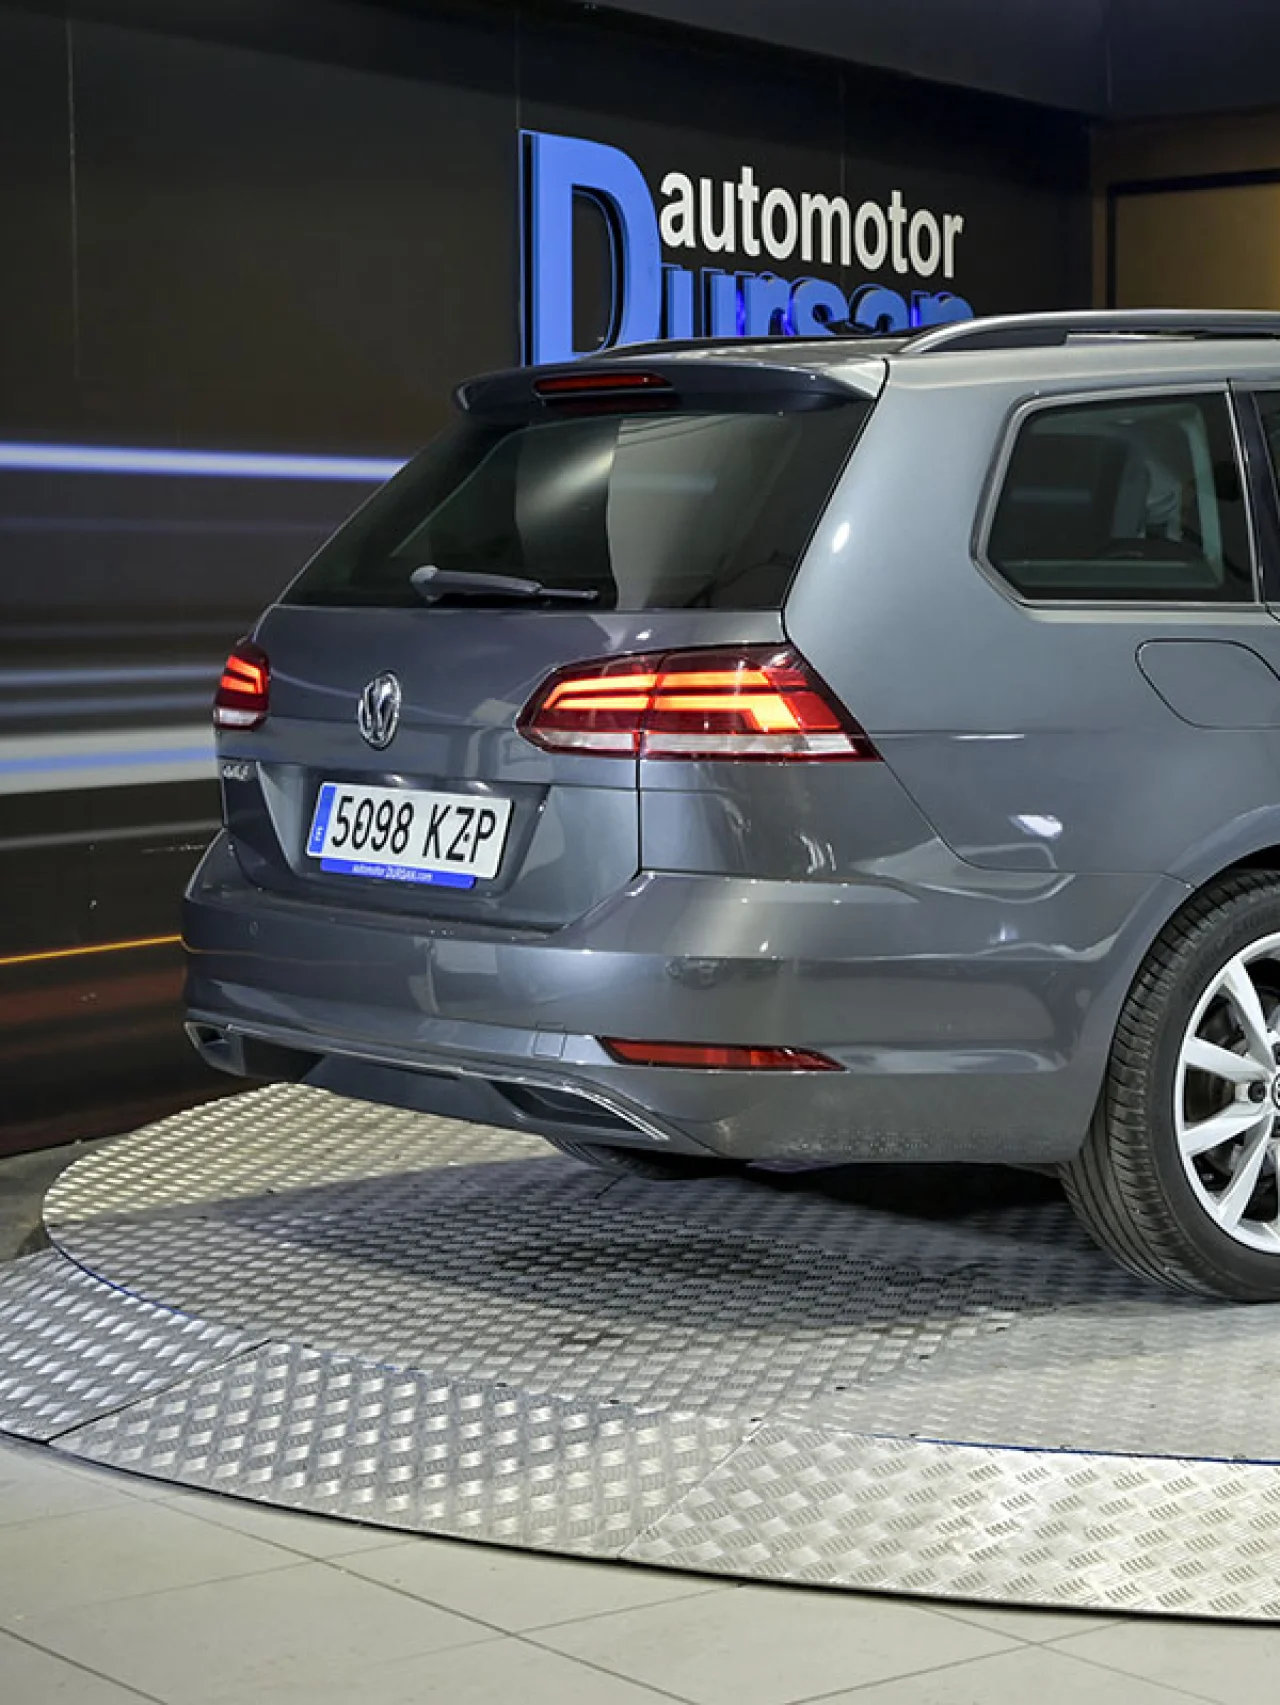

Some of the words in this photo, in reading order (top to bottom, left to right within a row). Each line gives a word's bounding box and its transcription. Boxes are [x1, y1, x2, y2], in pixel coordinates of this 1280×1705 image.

[518, 129, 974, 367] Durs
[660, 165, 964, 279] automotor
[331, 795, 415, 855] 5098
[422, 804, 496, 863] KZP
